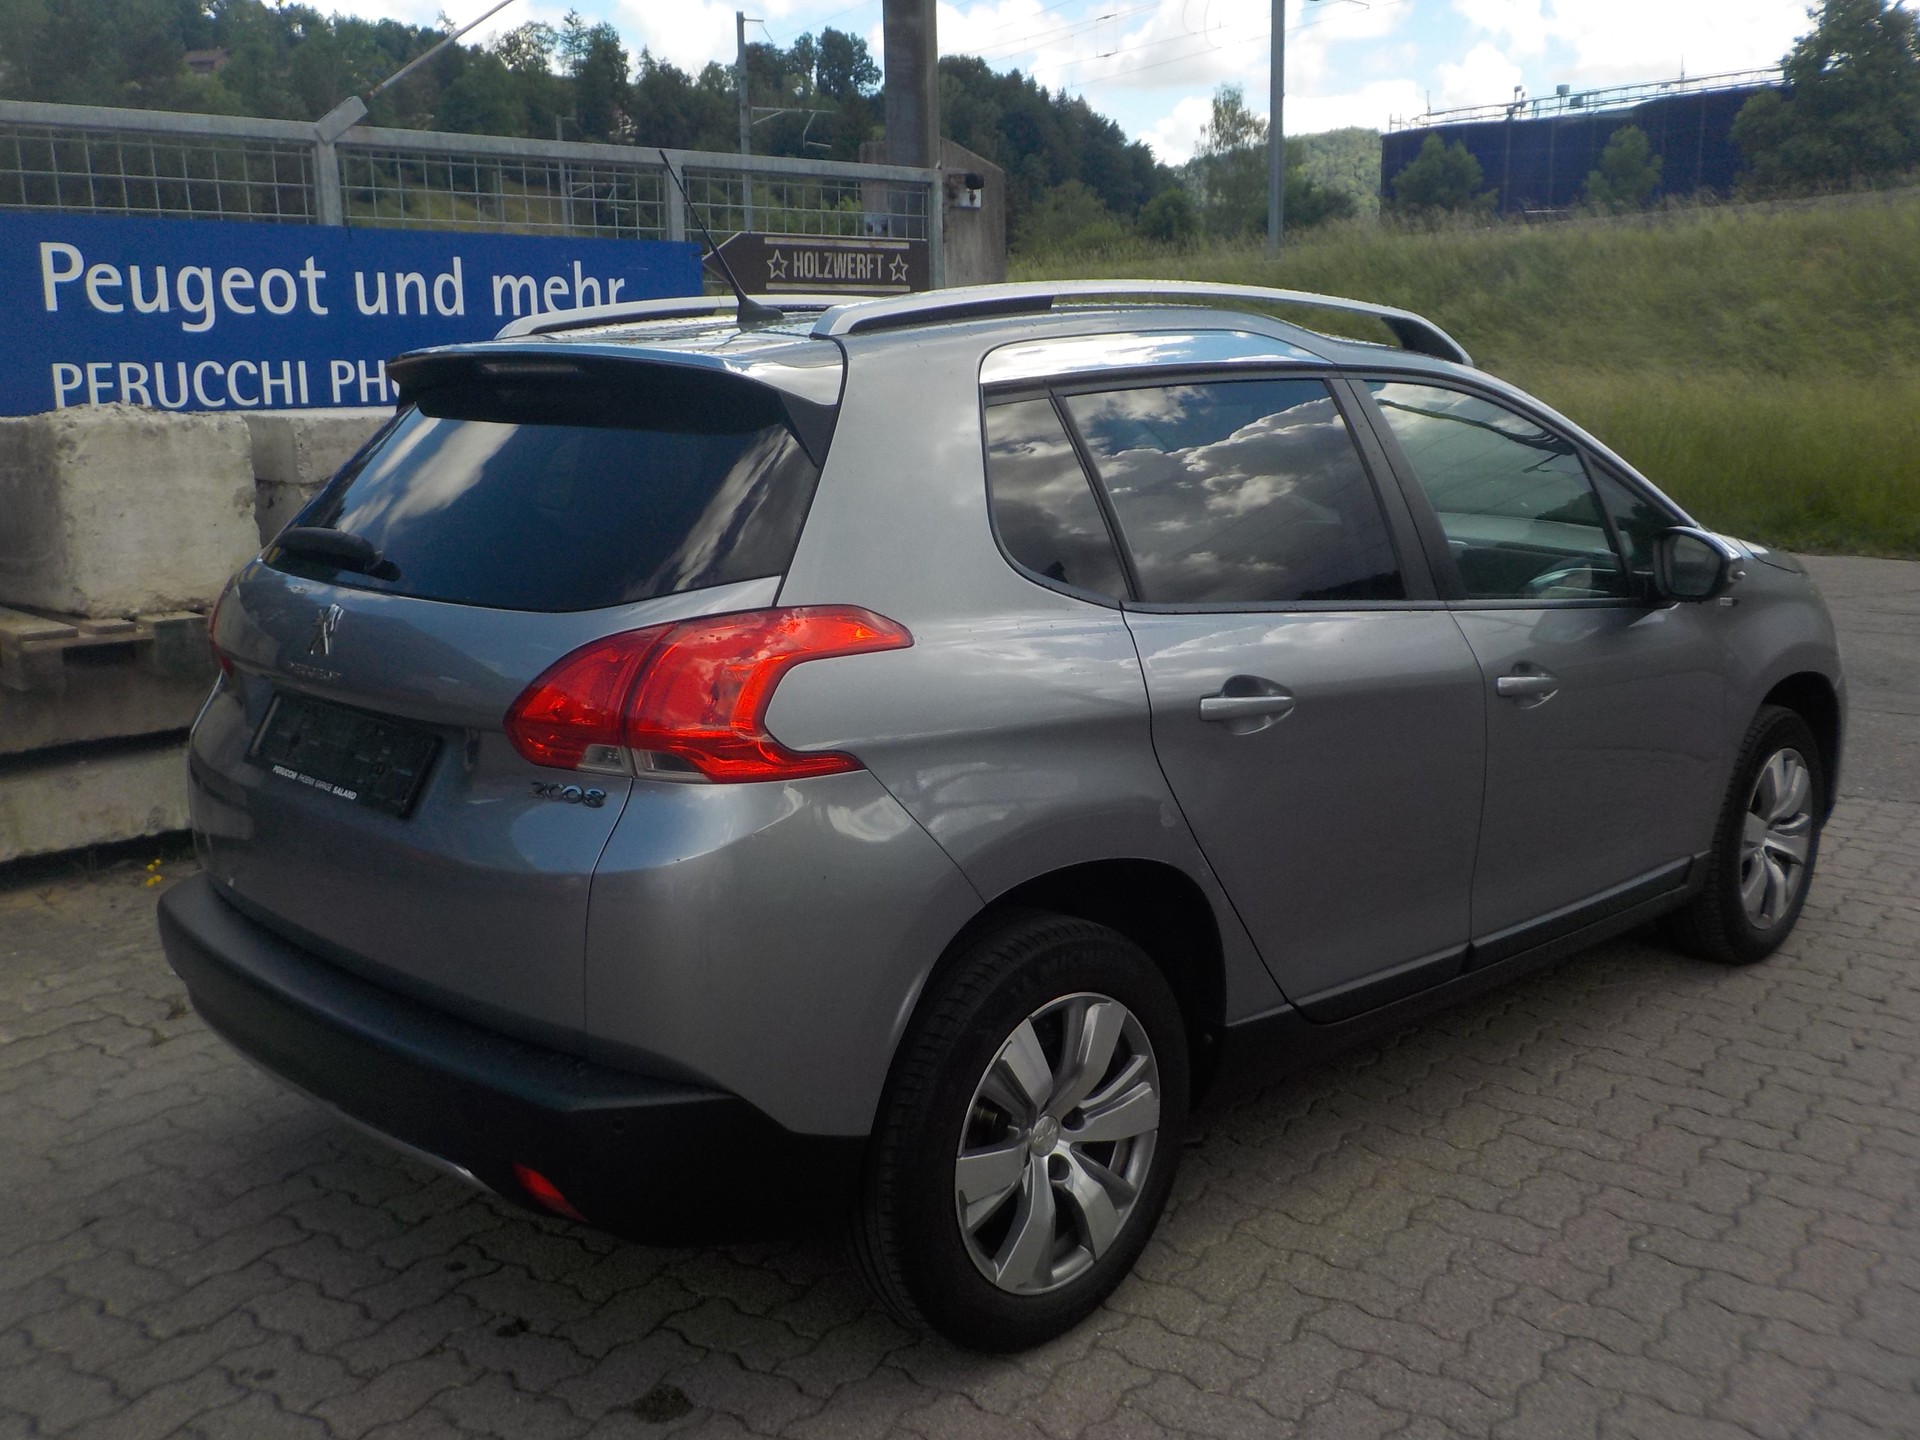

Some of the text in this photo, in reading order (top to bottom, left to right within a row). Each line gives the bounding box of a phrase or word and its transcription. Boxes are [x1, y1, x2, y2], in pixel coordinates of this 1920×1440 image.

[793, 250, 885, 279] HOLZWERFT
[40, 241, 626, 332] Peugeot und mehr
[51, 359, 400, 409] PERUCCHI PH
[332, 786, 357, 800] SALAND
[529, 781, 606, 808] 2008
